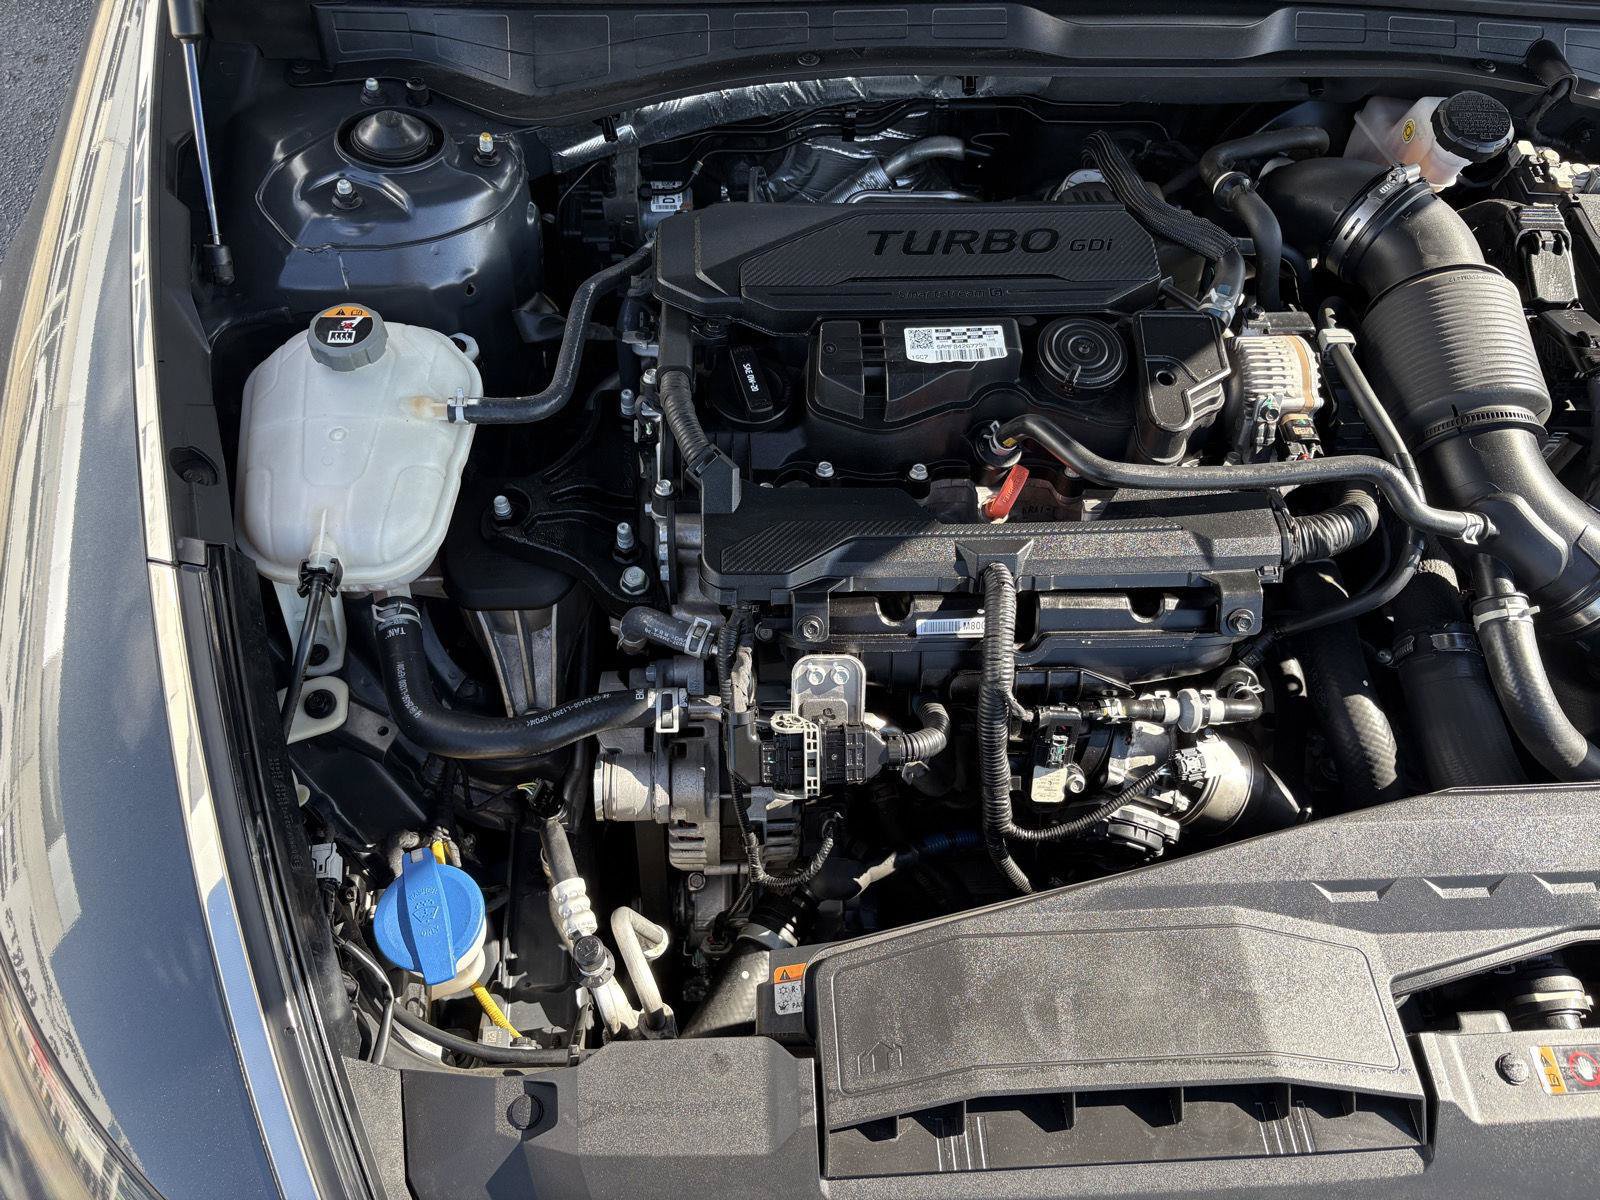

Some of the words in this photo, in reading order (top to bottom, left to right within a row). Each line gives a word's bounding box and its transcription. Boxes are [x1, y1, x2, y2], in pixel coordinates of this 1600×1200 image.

[866, 228, 1060, 256] TURBO
[1069, 235, 1113, 252] GDi
[743, 363, 753, 375] SAE
